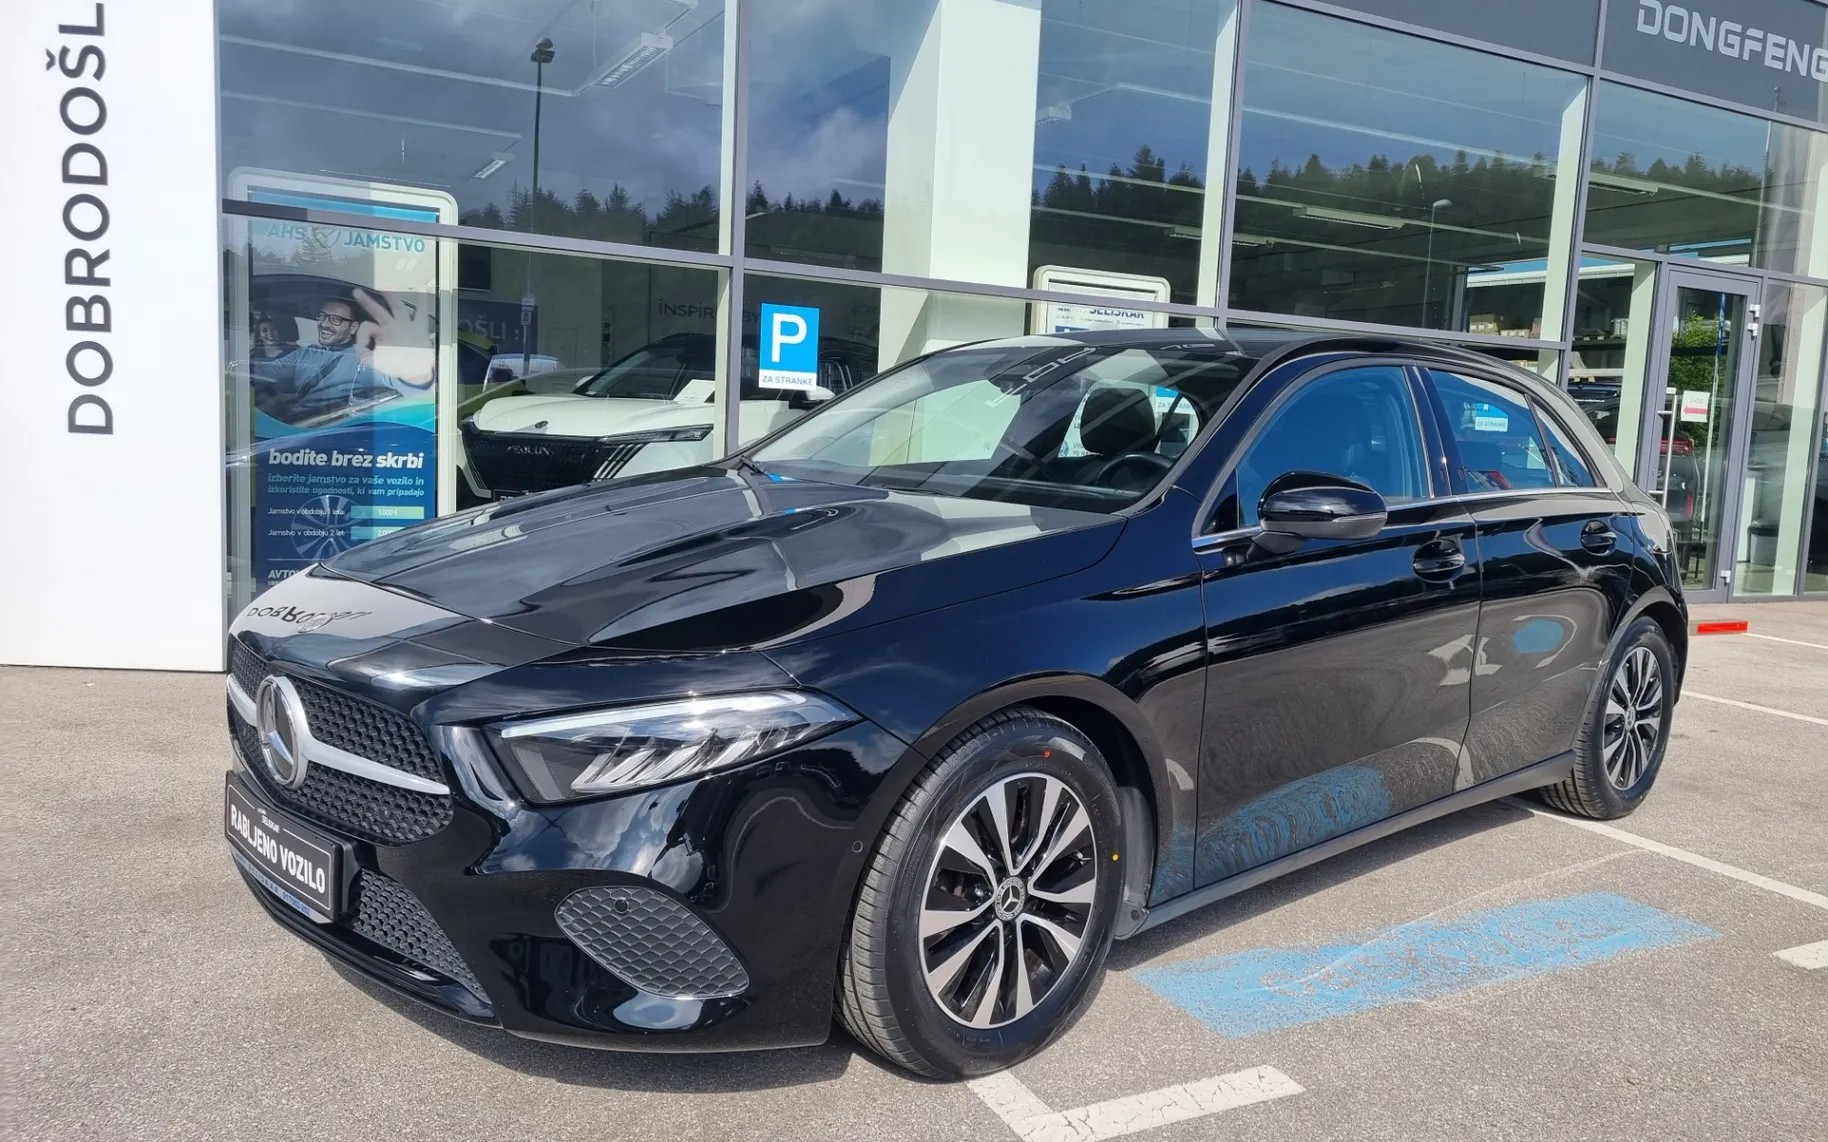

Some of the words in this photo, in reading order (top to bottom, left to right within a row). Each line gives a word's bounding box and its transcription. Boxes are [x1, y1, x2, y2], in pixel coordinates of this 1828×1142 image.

[1637, 0, 1828, 82] DONGFENG
[46, 2, 114, 435] DOBRODOŠL
[266, 223, 305, 240] AHS
[344, 231, 425, 253] JAMSTVO
[771, 312, 807, 363] P
[762, 375, 774, 383] ZA
[775, 376, 813, 386] STRANKE
[268, 447, 328, 466] bodite
[331, 450, 374, 467] brez
[375, 451, 425, 469] skrbi
[268, 472, 306, 483] izberite
[307, 473, 347, 485] jamstvo
[348, 476, 360, 484] za
[362, 474, 385, 485] vaše
[386, 476, 414, 486] vozilo
[415, 476, 425, 486] in
[268, 484, 310, 493] izkoristite
[312, 486, 355, 496] ugodnosti,
[357, 487, 366, 495] ki
[367, 488, 386, 496] vam
[387, 488, 425, 498] pripadajo
[268, 507, 296, 515] Jamstvo
[301, 507, 327, 516] obdobju
[303, 529, 329, 537] obdobju
[231, 804, 278, 864] RABLJENO
[279, 844, 326, 894] VOZILO
